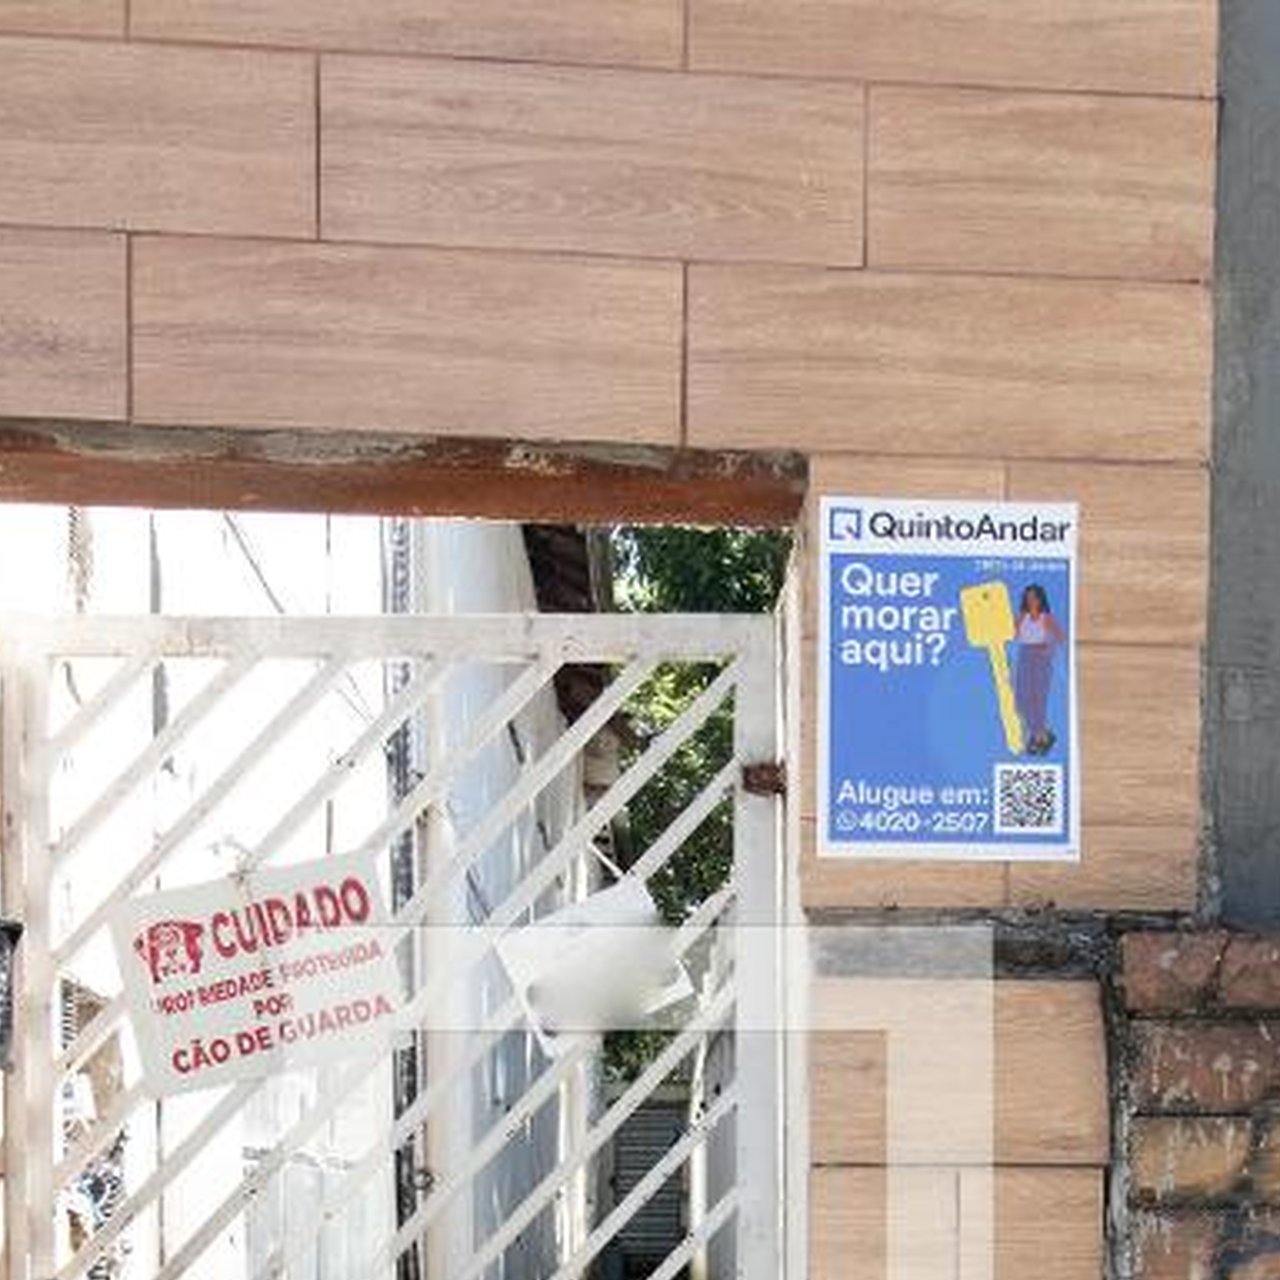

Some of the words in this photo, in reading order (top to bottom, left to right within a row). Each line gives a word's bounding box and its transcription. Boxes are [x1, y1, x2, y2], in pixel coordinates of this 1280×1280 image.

[869, 511, 1070, 542] QuintoAndar
[841, 562, 939, 597] Quer
[841, 604, 957, 631] morar
[841, 632, 946, 671] aqui?
[836, 779, 934, 811] Alugue
[940, 787, 989, 804] em:
[211, 877, 371, 958] CUIDADO
[252, 993, 293, 1019] POR
[172, 1038, 231, 1074] CÃO
[236, 1026, 273, 1056] DE
[278, 994, 394, 1043] GUARDA
